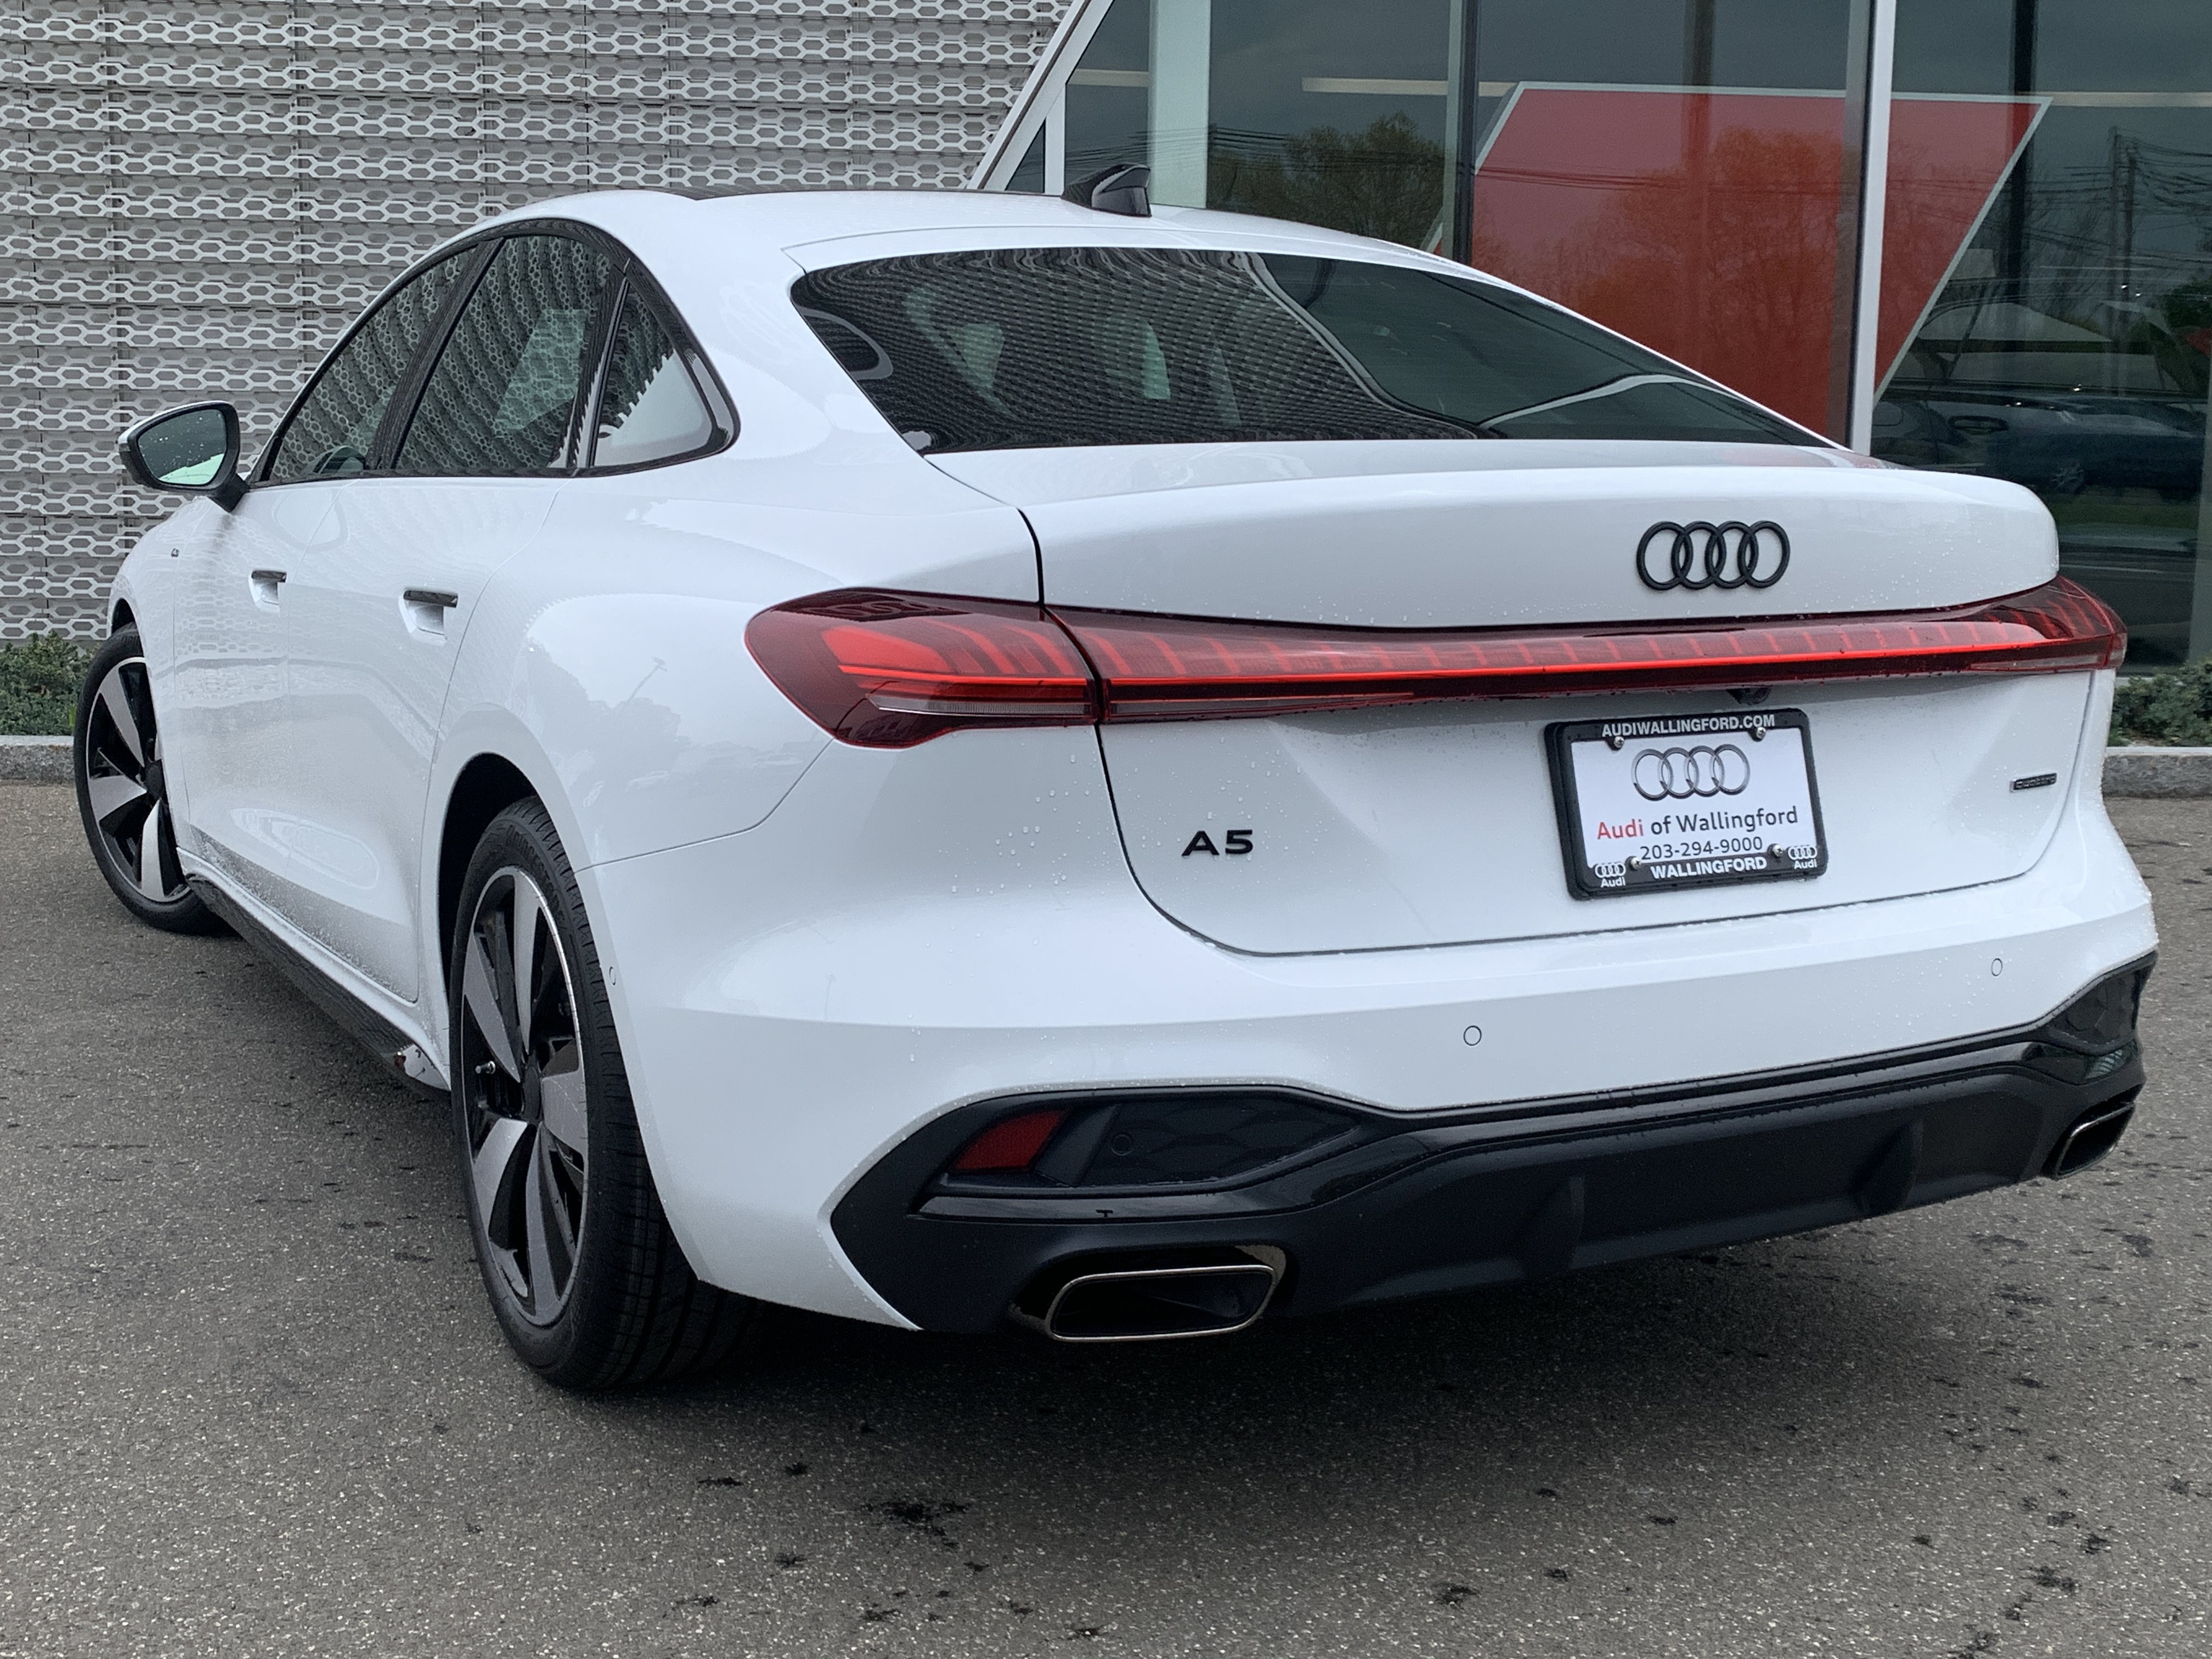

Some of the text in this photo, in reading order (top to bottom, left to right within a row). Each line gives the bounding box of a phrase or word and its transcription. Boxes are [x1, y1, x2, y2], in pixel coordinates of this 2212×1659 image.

[1601, 714, 1775, 737] AUDIWALLINGFORD.COM
[1597, 806, 1798, 839] Audi of Wallingford
[1181, 829, 1253, 856] A5
[1640, 836, 1763, 860] 203-294-9000
[1650, 856, 1767, 879] WALLINGFORD
[1794, 859, 1817, 870] Audi
[1600, 877, 1626, 888] Audi
